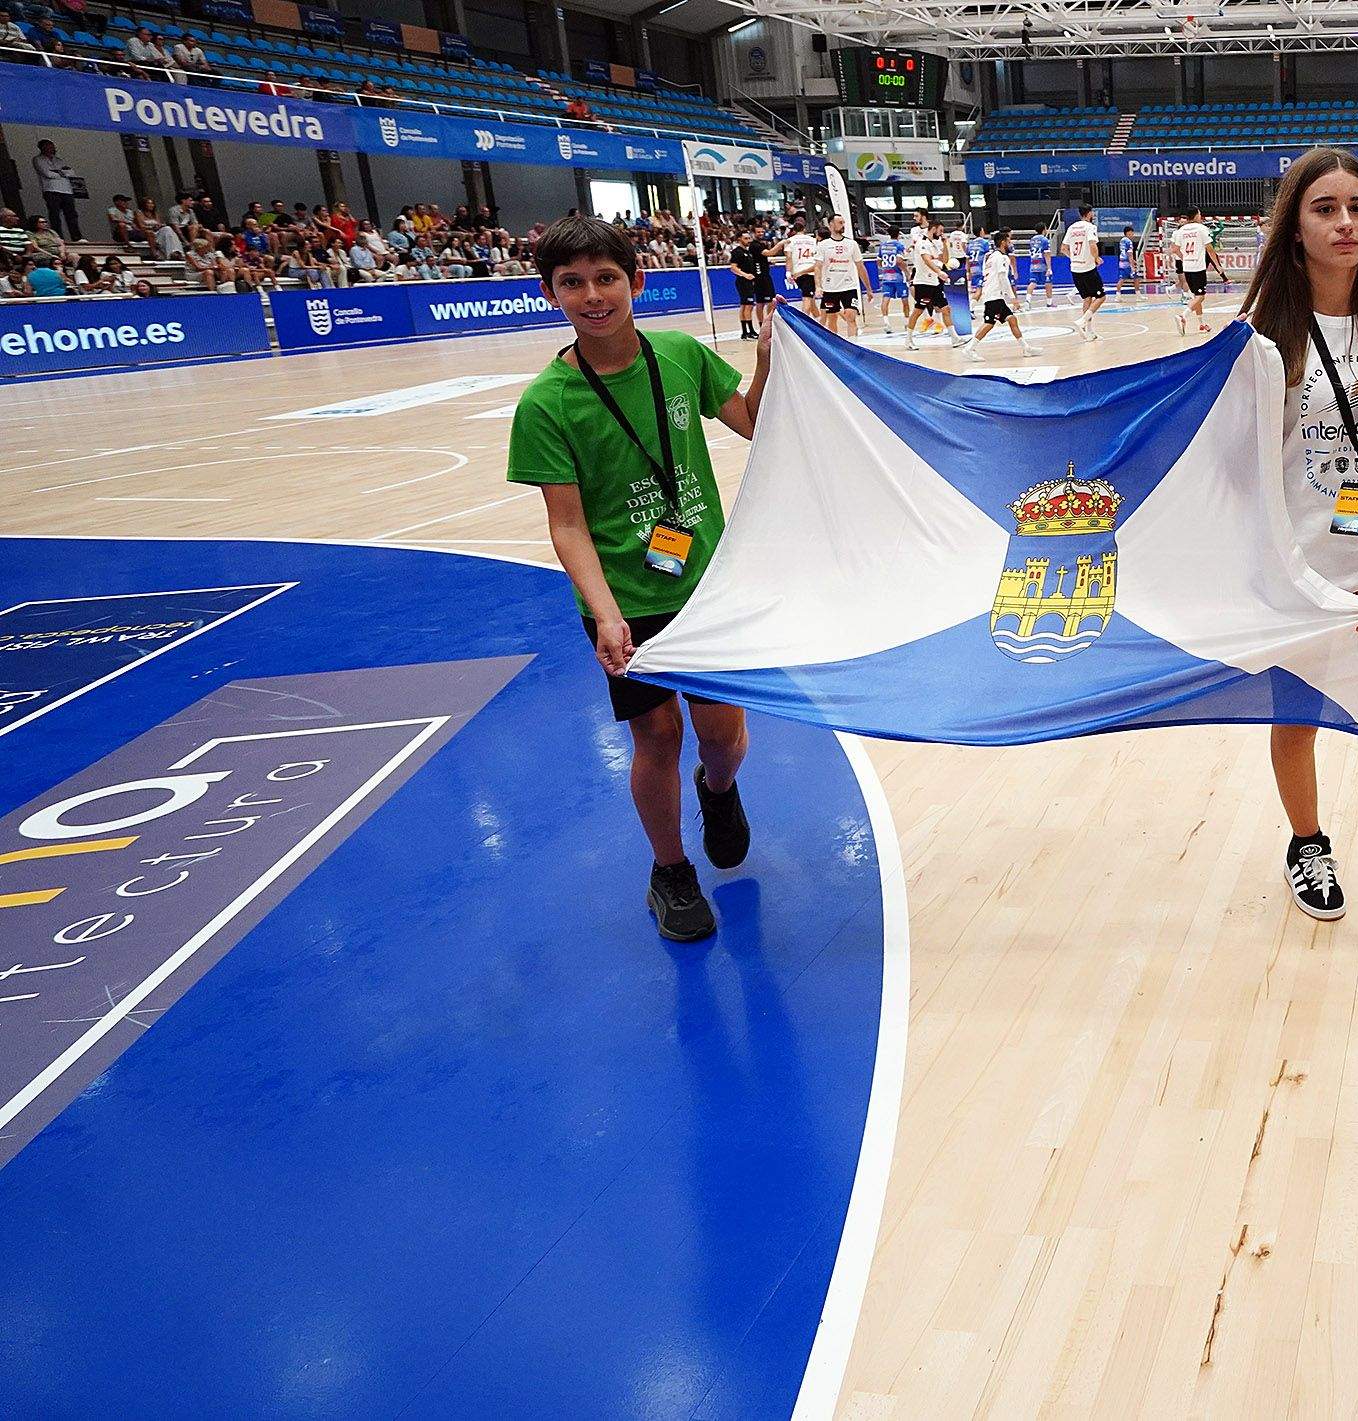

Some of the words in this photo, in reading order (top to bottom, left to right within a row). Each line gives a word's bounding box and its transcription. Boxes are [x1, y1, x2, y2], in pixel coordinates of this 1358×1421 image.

[876, 56, 885, 69] 0
[906, 59, 914, 71] 0
[878, 74, 905, 86] 00:00
[104, 87, 325, 141] Pontevedra
[1127, 157, 1237, 176] Pontevedra
[797, 247, 811, 260] 14
[970, 249, 980, 262] 31
[1073, 241, 1083, 256] 37
[881, 254, 897, 268] 89
[1218, 253, 1253, 268] FROI
[430, 293, 560, 320] www.zoeho
[0, 322, 185, 356] ehome.es
[1301, 368, 1324, 419] TORNEO
[66, 629, 178, 647] TRAWL
